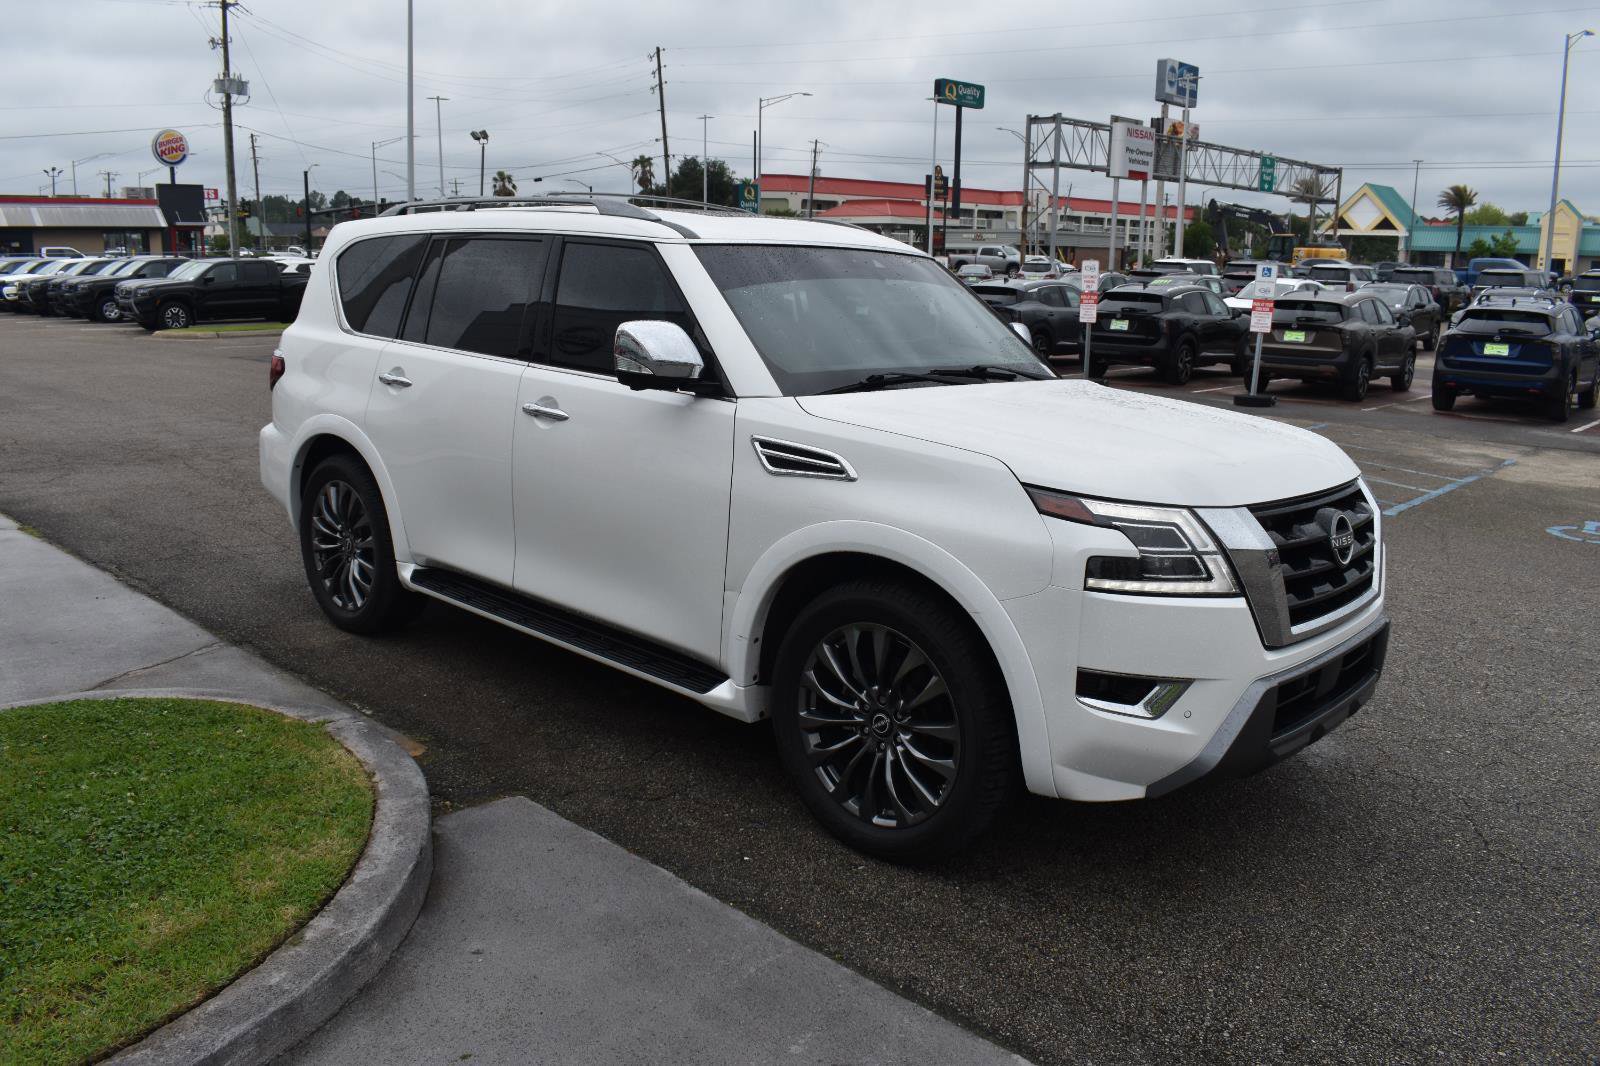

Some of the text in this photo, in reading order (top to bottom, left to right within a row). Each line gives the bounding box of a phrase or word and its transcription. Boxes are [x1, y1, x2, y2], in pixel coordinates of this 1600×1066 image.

[958, 84, 981, 98] Quality
[1126, 127, 1155, 141] NISSAN
[158, 136, 184, 149] BURGER
[160, 143, 186, 157] KING
[1125, 146, 1153, 157] Pre-Owned
[1128, 157, 1150, 166] Vehicles
